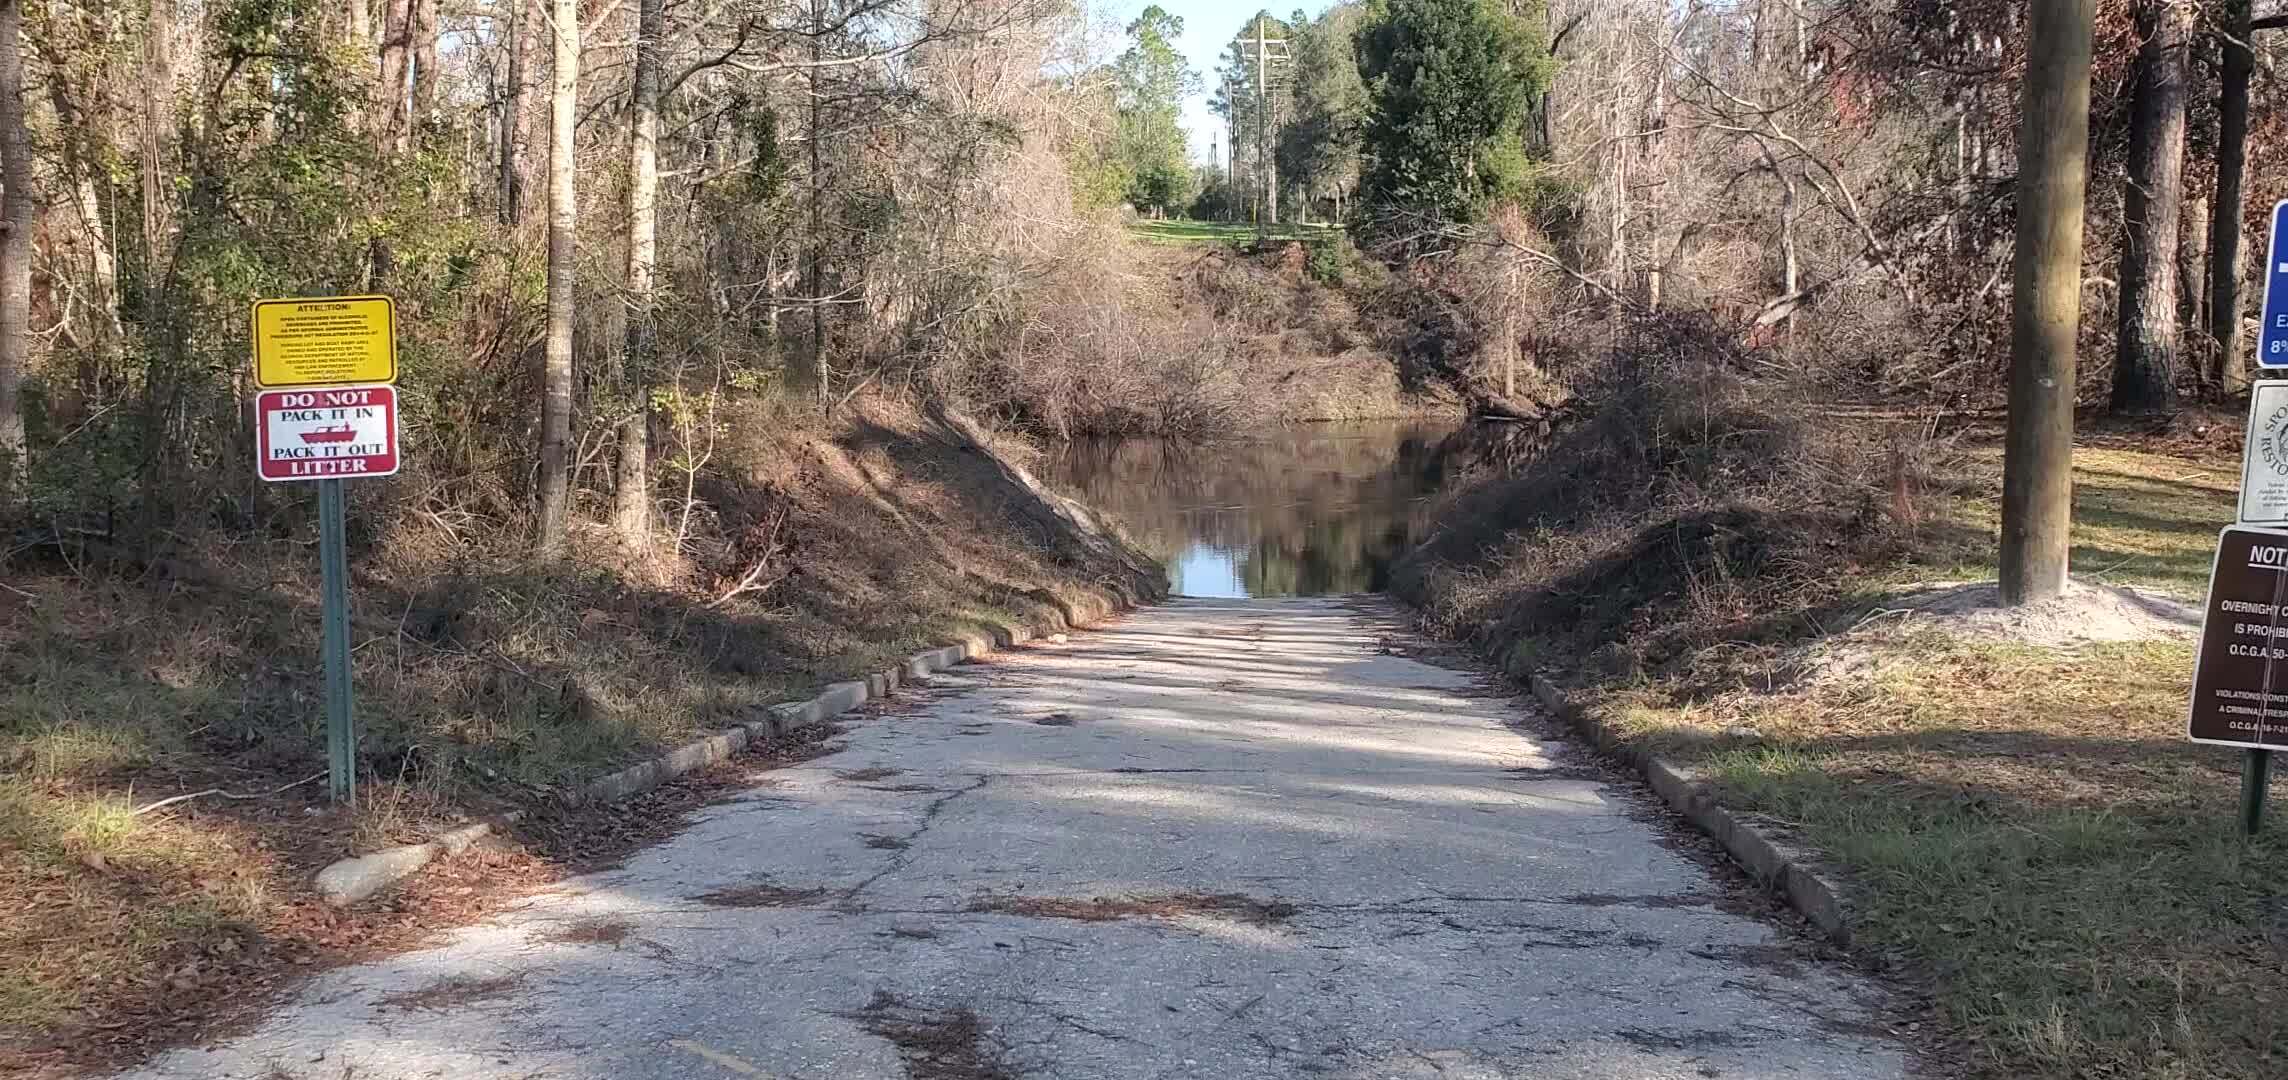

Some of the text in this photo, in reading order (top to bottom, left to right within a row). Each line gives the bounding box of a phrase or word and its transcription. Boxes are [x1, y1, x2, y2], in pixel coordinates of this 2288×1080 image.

[297, 304, 352, 312] ATTETION:
[2276, 314, 2288, 328] E
[282, 391, 372, 407] DO NOT
[282, 408, 373, 421] PACK IT IN
[2264, 404, 2288, 432] SPO
[274, 444, 383, 458] PACK IT OUT
[291, 458, 367, 474] LITTER
[2221, 600, 2280, 616] OVERNIGHT
[2234, 623, 2244, 634] IS
[2216, 689, 2260, 700] VIOLATIONS
